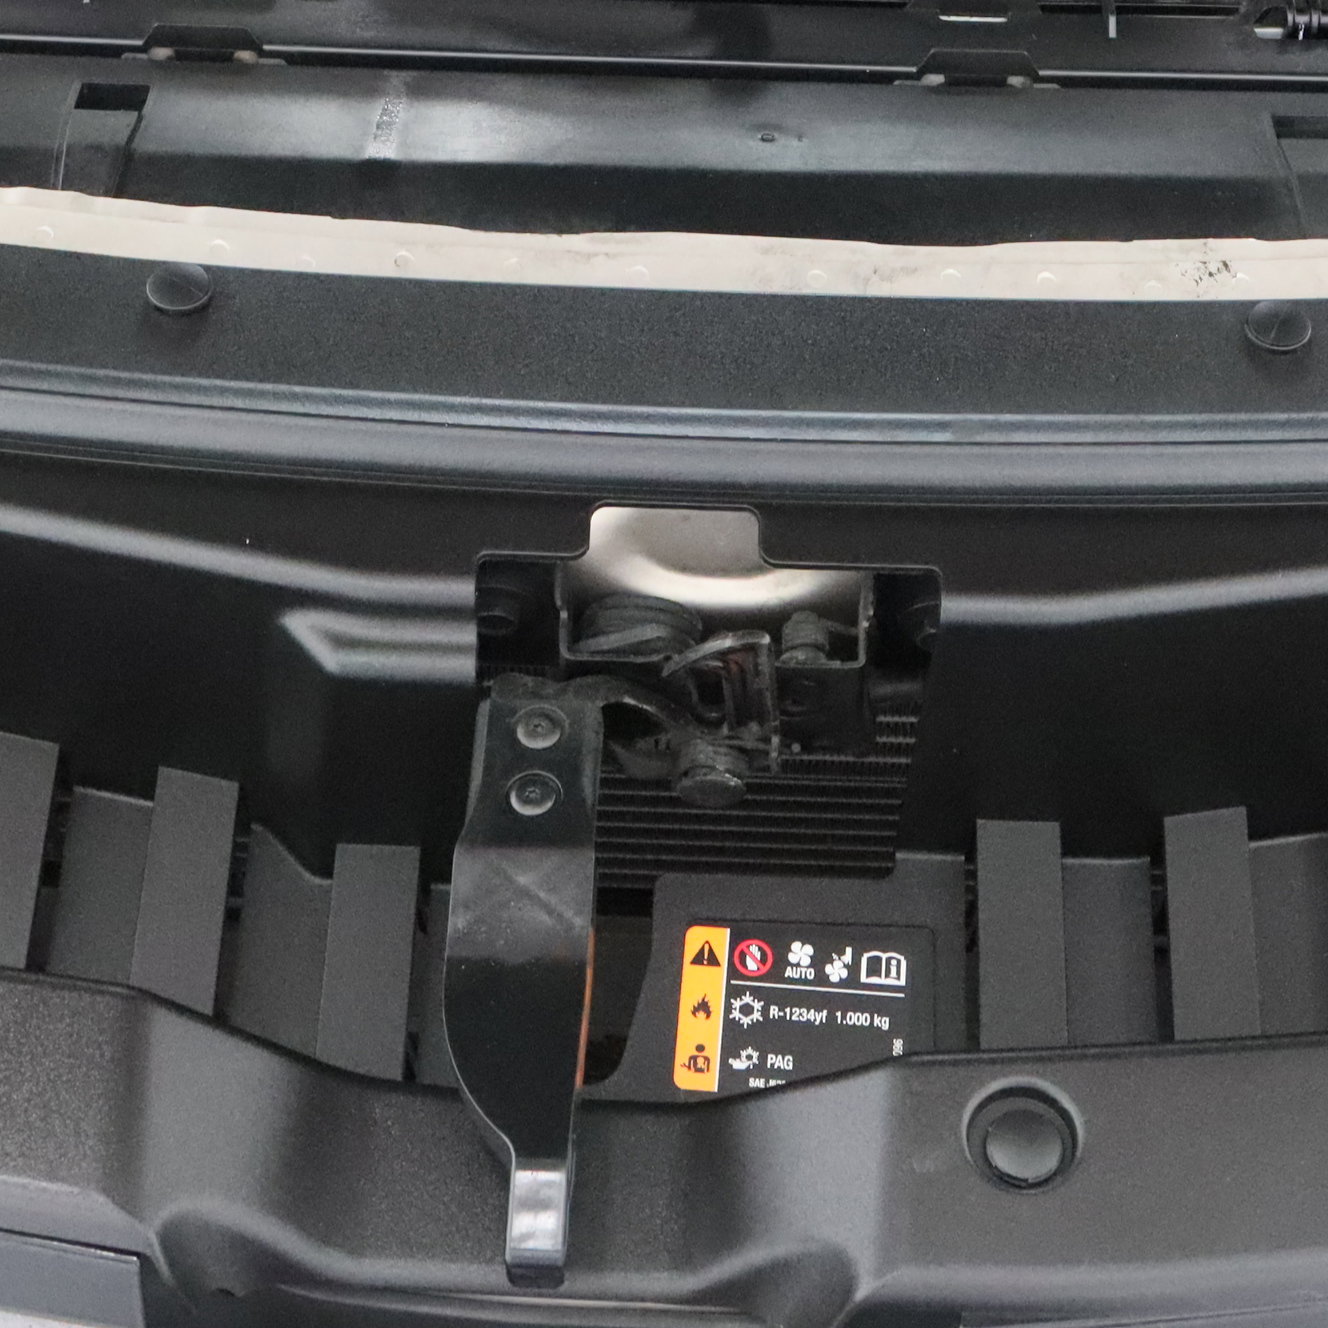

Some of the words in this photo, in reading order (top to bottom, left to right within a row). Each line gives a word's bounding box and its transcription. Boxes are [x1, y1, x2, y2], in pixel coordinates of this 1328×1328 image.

[784, 966, 815, 980] AUTO
[769, 1005, 828, 1025] R-1234yf
[835, 1010, 870, 1027] 1.000
[873, 1013, 890, 1031] kg
[767, 1053, 794, 1071] PAG
[748, 1077, 765, 1089] SAE
